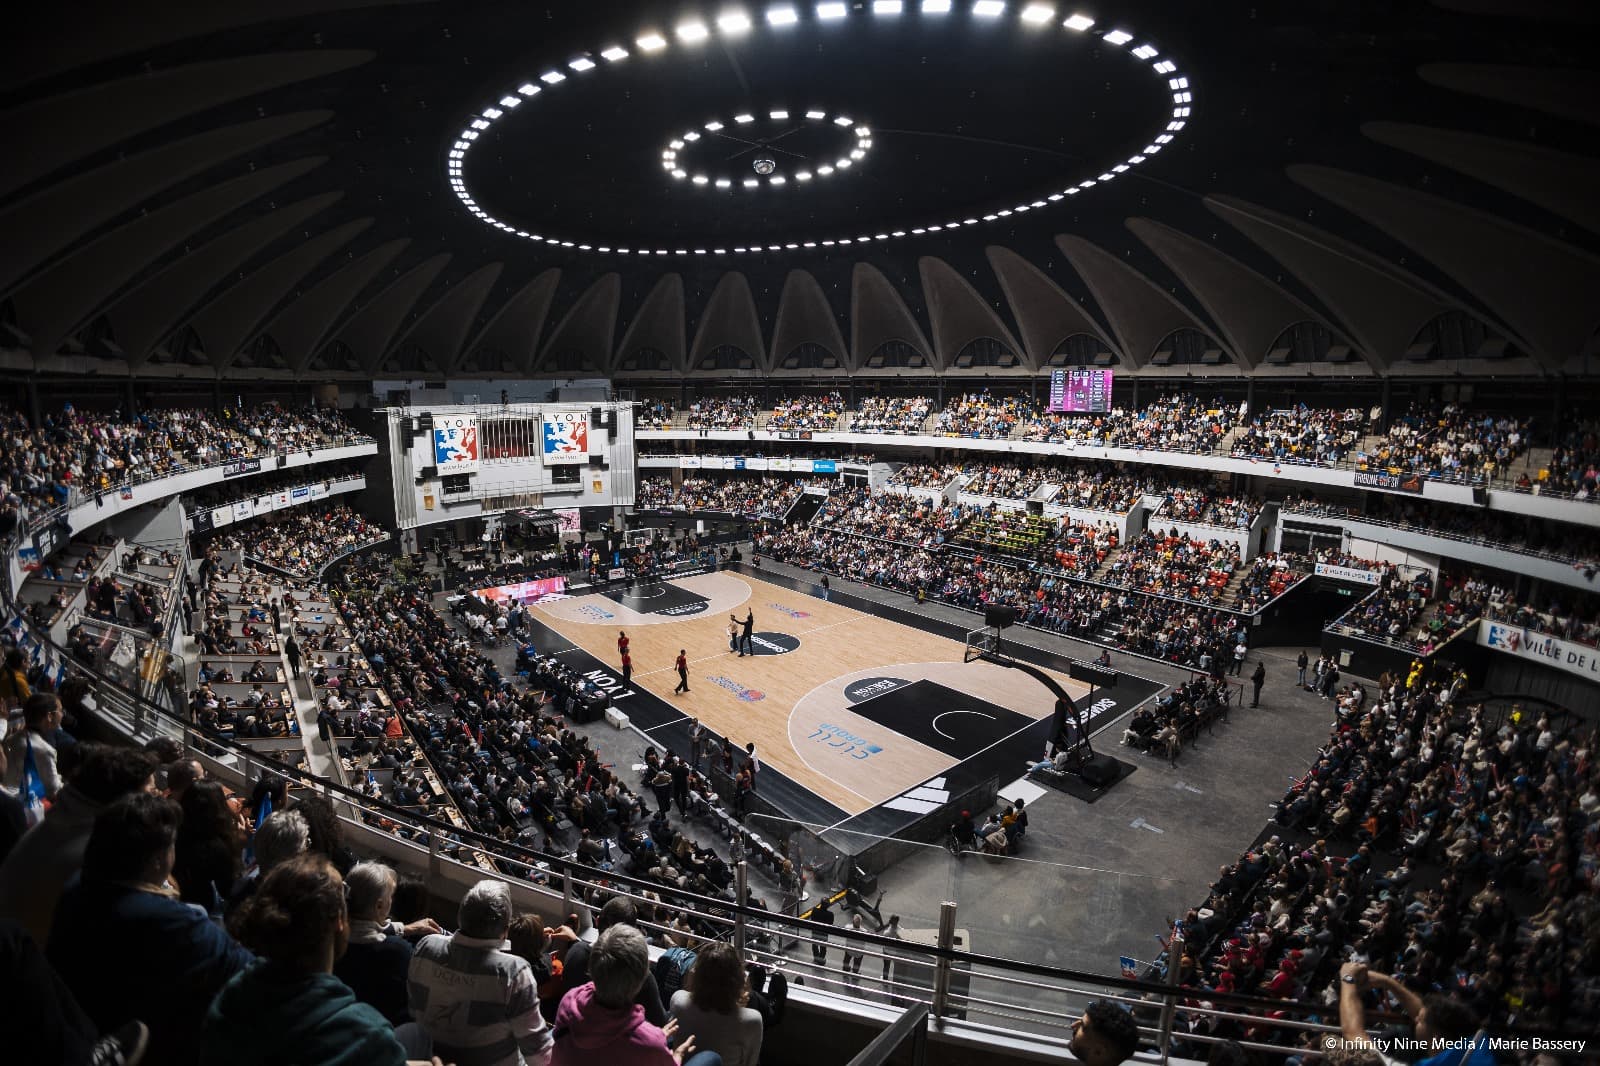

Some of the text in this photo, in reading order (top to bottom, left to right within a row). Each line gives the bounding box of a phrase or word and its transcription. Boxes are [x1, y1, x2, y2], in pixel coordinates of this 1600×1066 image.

[1524, 639, 1562, 660] VILLE
[1567, 651, 1586, 667] DE
[582, 669, 636, 700] LYON
